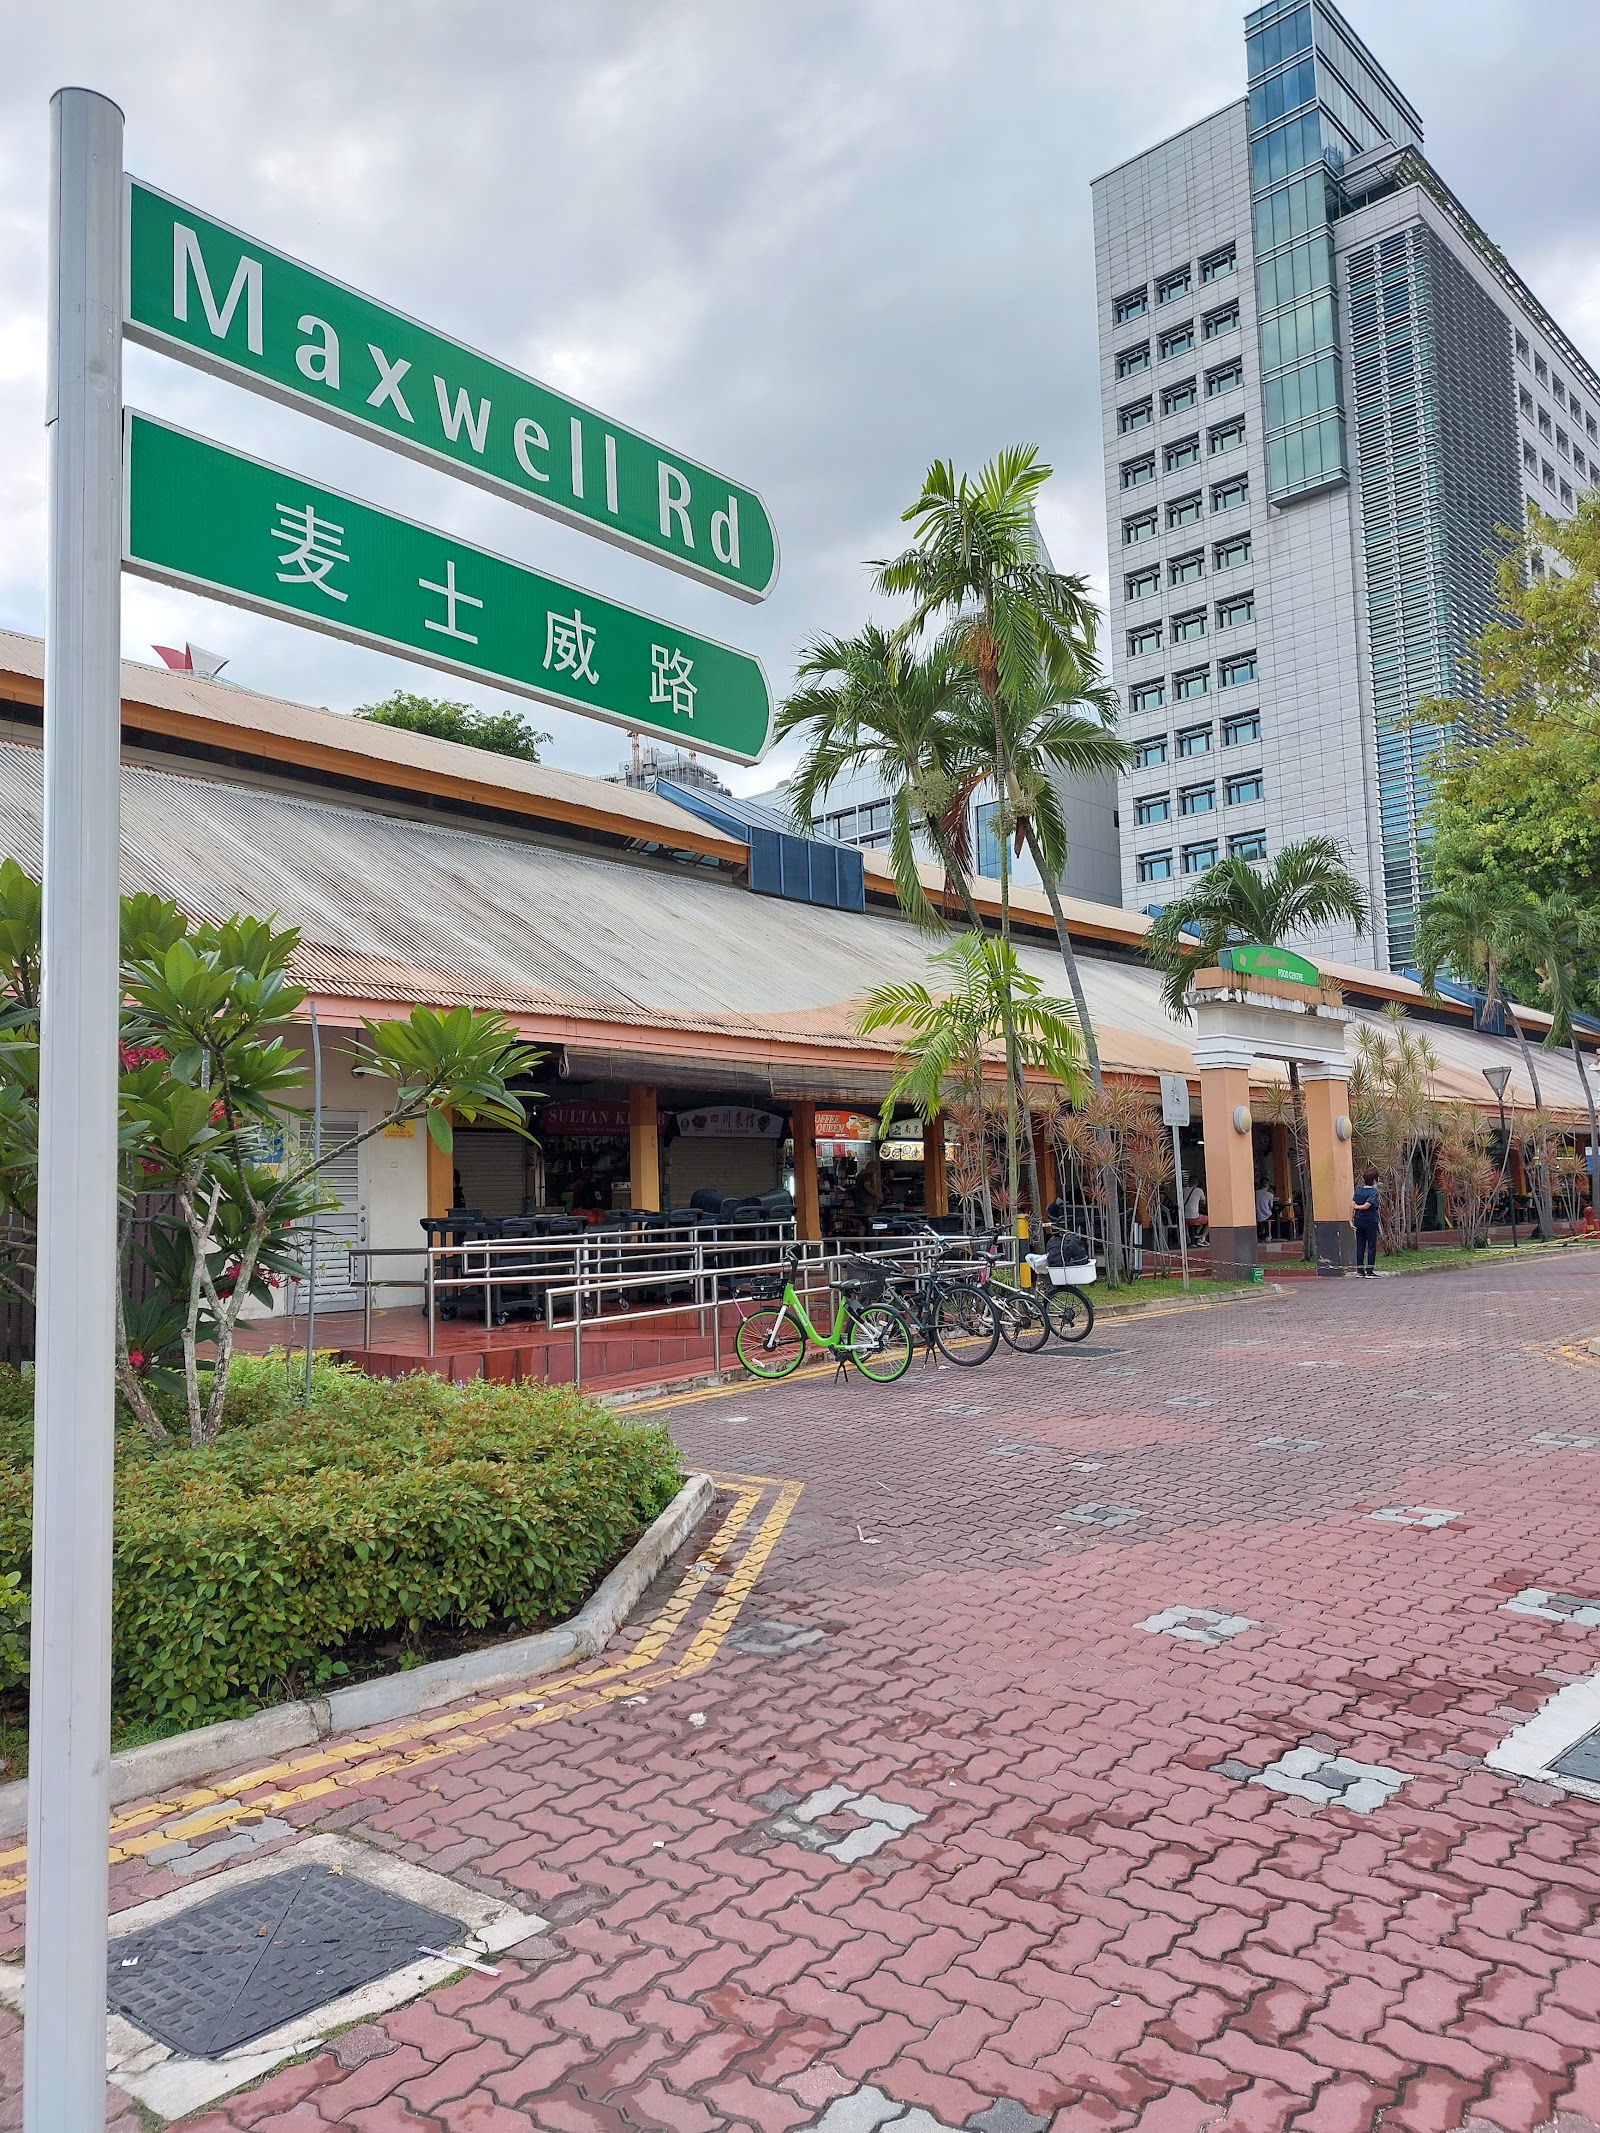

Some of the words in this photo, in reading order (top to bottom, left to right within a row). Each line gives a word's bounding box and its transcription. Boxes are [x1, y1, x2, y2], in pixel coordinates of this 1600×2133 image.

[173, 221, 619, 514] Maxwell
[657, 460, 741, 569] Rd
[270, 502, 698, 719] 麦士威路
[1277, 968, 1289, 979] FOOD
[1289, 971, 1304, 981] CENTRE
[548, 1108, 609, 1124] SULTAN
[815, 1114, 841, 1124] OFFEE
[816, 1123, 845, 1135] QUEEN
